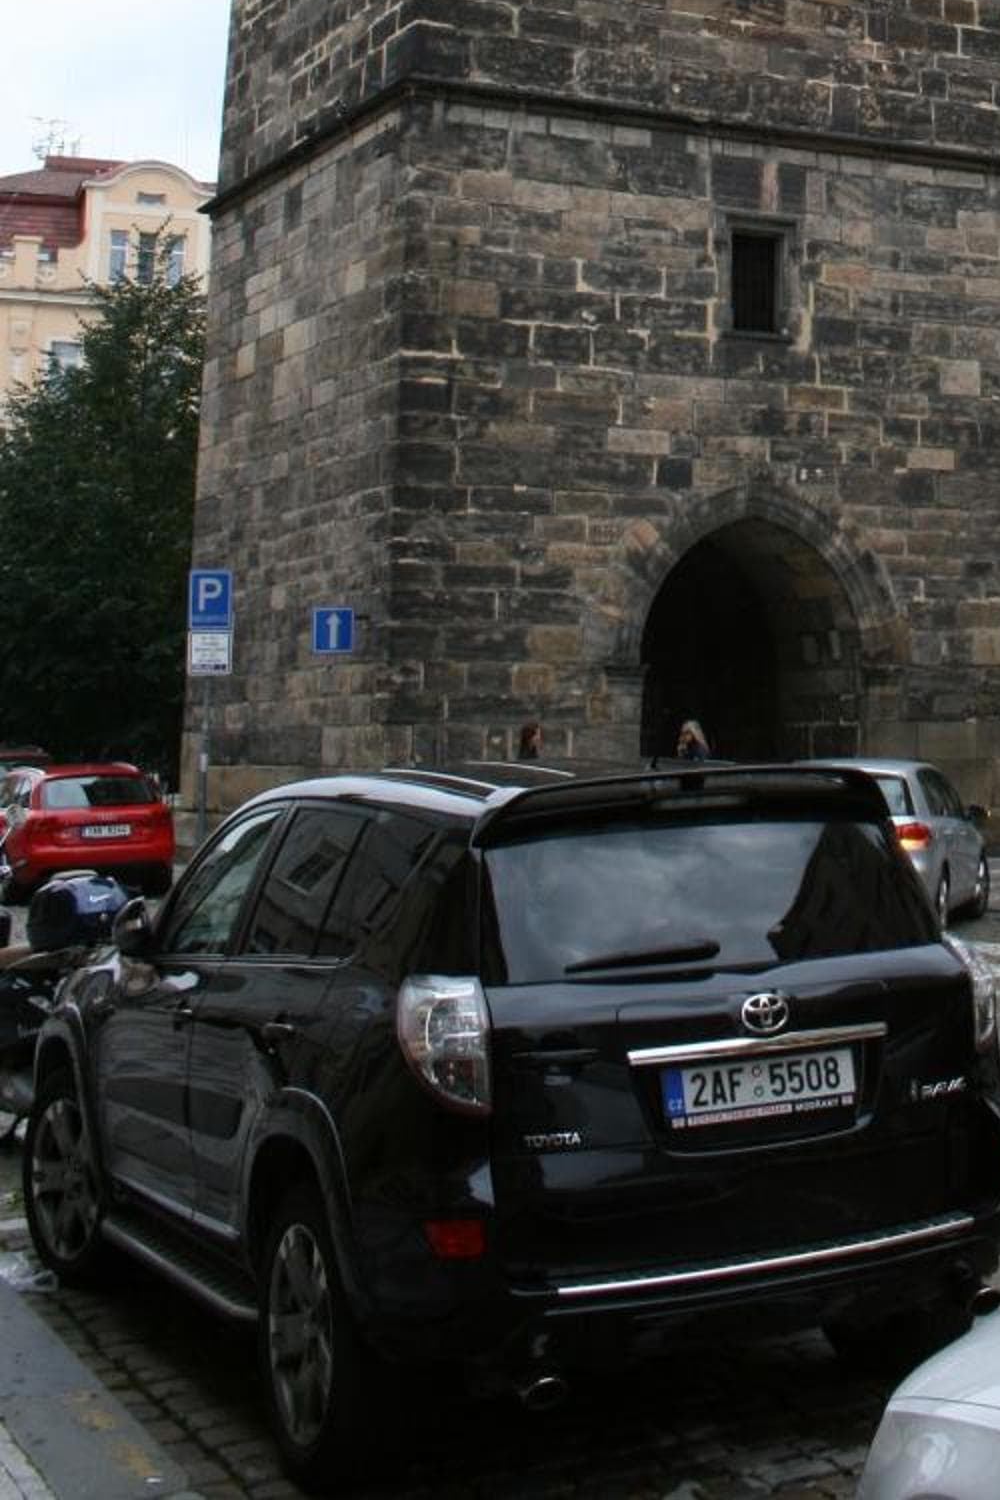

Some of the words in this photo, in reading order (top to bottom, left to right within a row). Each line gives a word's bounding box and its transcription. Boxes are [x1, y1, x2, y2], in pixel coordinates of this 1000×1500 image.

[199, 578, 222, 612] P
[691, 1067, 743, 1107] 2AF
[769, 1056, 840, 1097] 5508
[524, 1131, 581, 1148] TOYOTA
